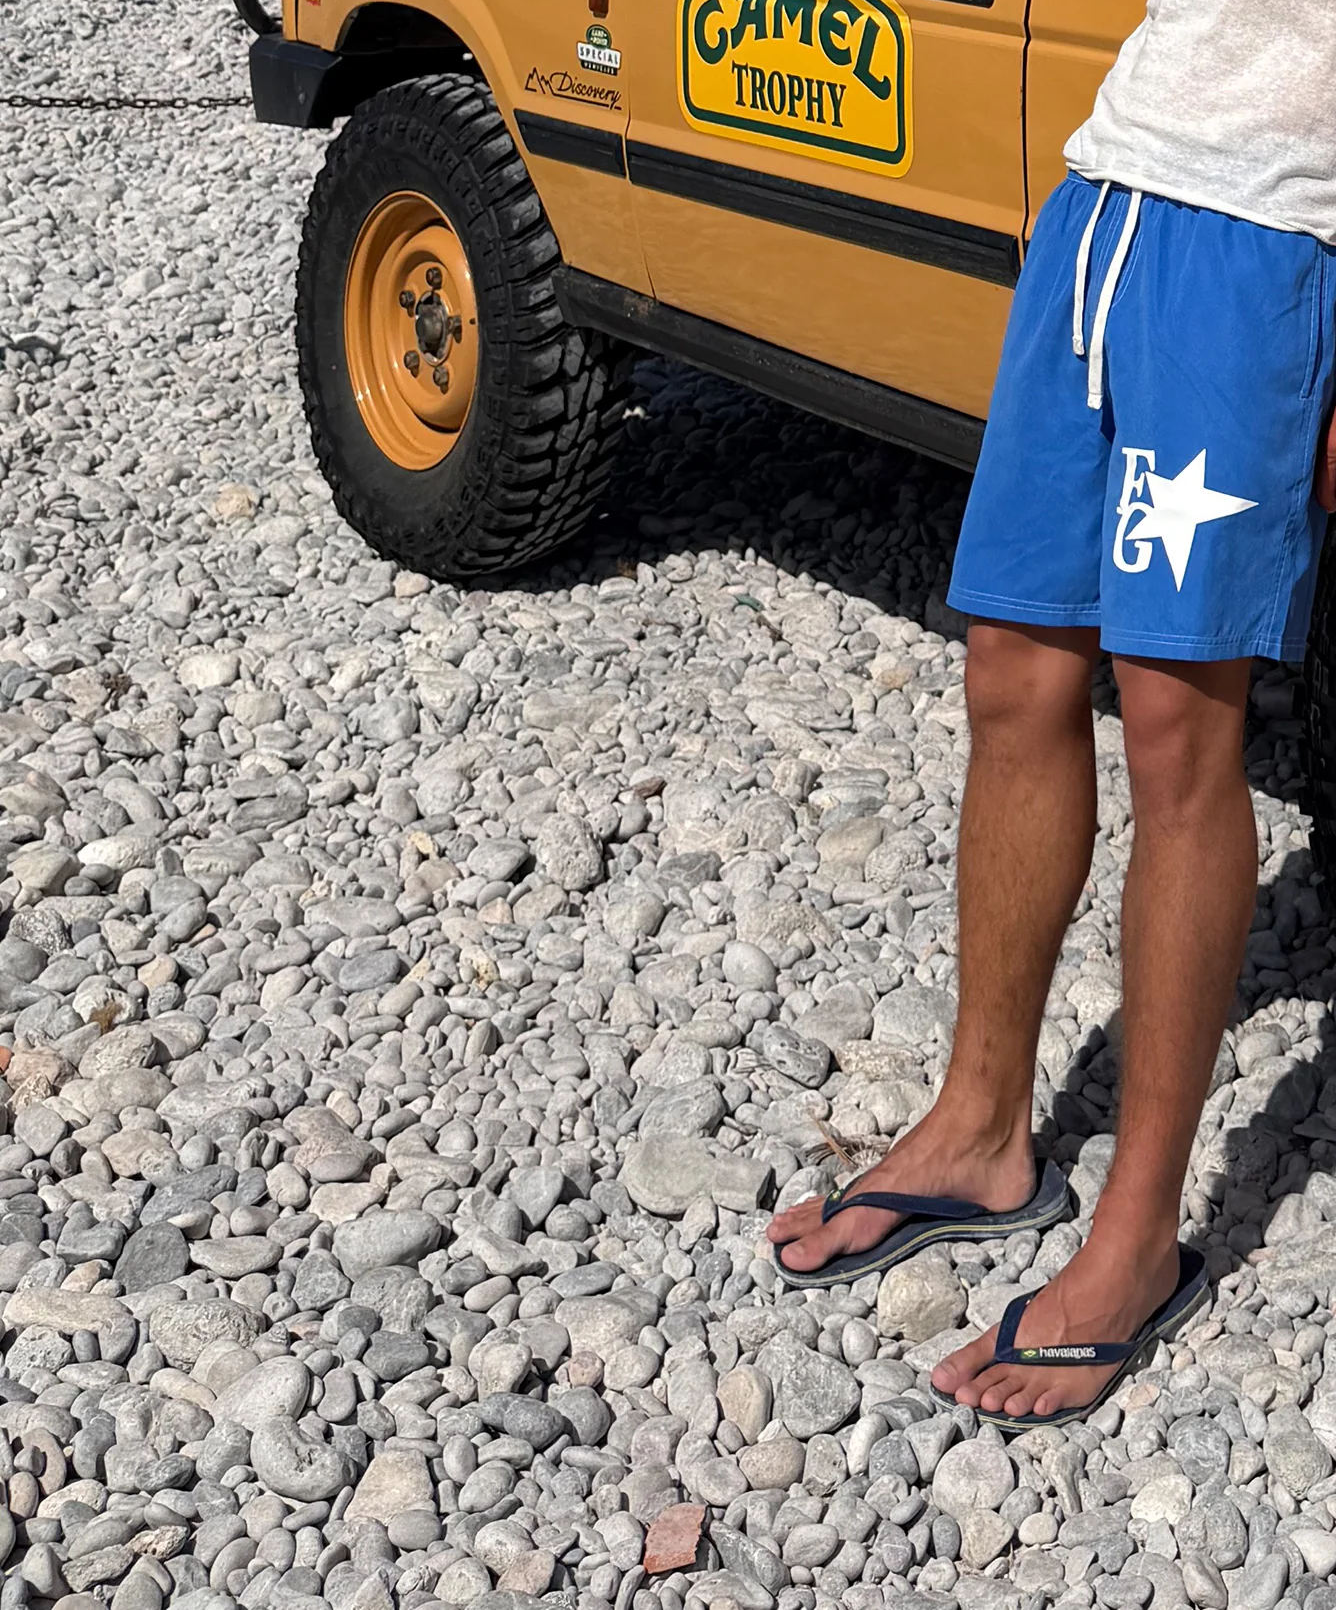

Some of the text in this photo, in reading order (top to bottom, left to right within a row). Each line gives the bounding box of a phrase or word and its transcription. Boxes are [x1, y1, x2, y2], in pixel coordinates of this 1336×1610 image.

[579, 46, 618, 65] SPECIAL
[550, 71, 622, 110] Discovery
[731, 60, 847, 128] TROPHY
